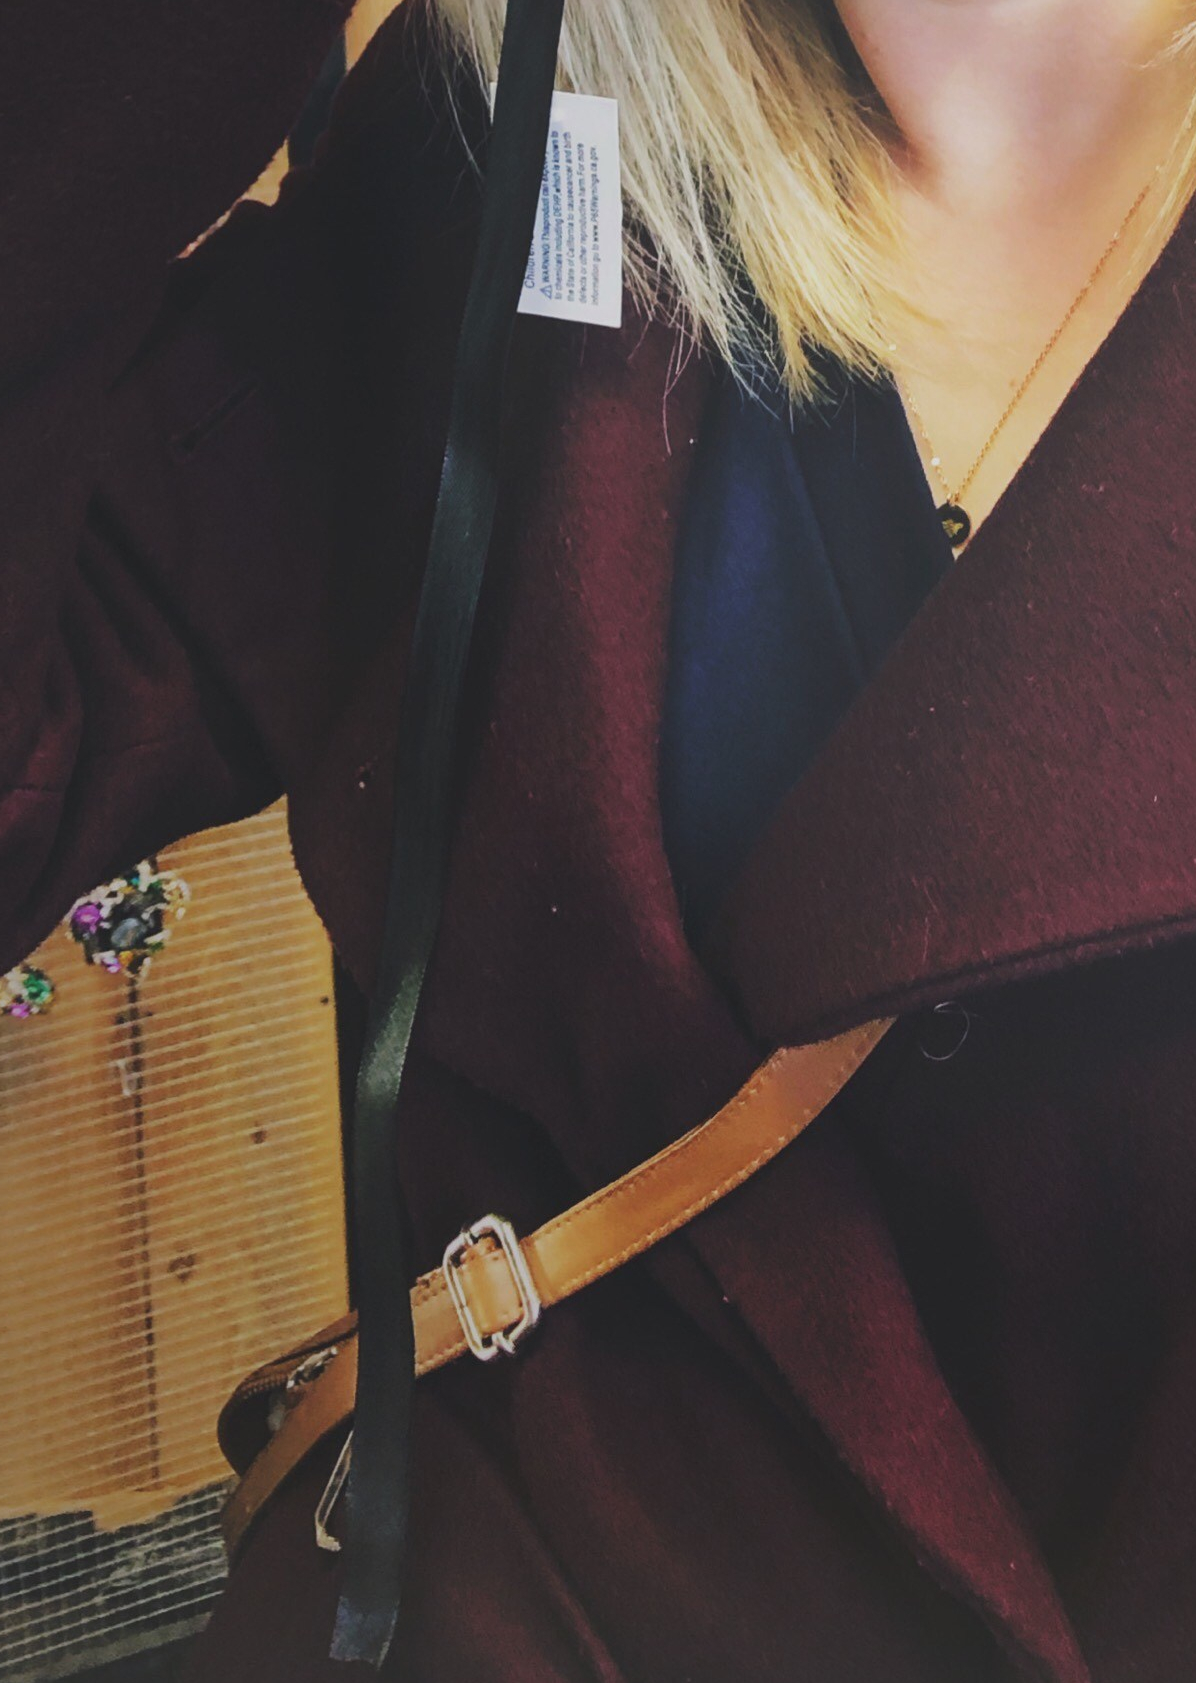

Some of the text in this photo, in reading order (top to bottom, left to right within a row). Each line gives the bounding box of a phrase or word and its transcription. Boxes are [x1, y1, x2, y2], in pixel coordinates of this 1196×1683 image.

[551, 130, 559, 138] to
[562, 131, 572, 148] birth
[552, 139, 560, 163] known
[564, 149, 572, 164] and
[577, 143, 585, 162] more
[566, 213, 574, 221] to
[578, 198, 588, 245] reproductive
[554, 218, 564, 252] including
[566, 222, 574, 258] California
[566, 258, 574, 267] of
[579, 246, 587, 265] other
[554, 253, 562, 291] chemicals
[566, 268, 574, 288] State
[580, 266, 587, 275] or
[554, 292, 562, 300] to
[578, 276, 587, 304] defects
